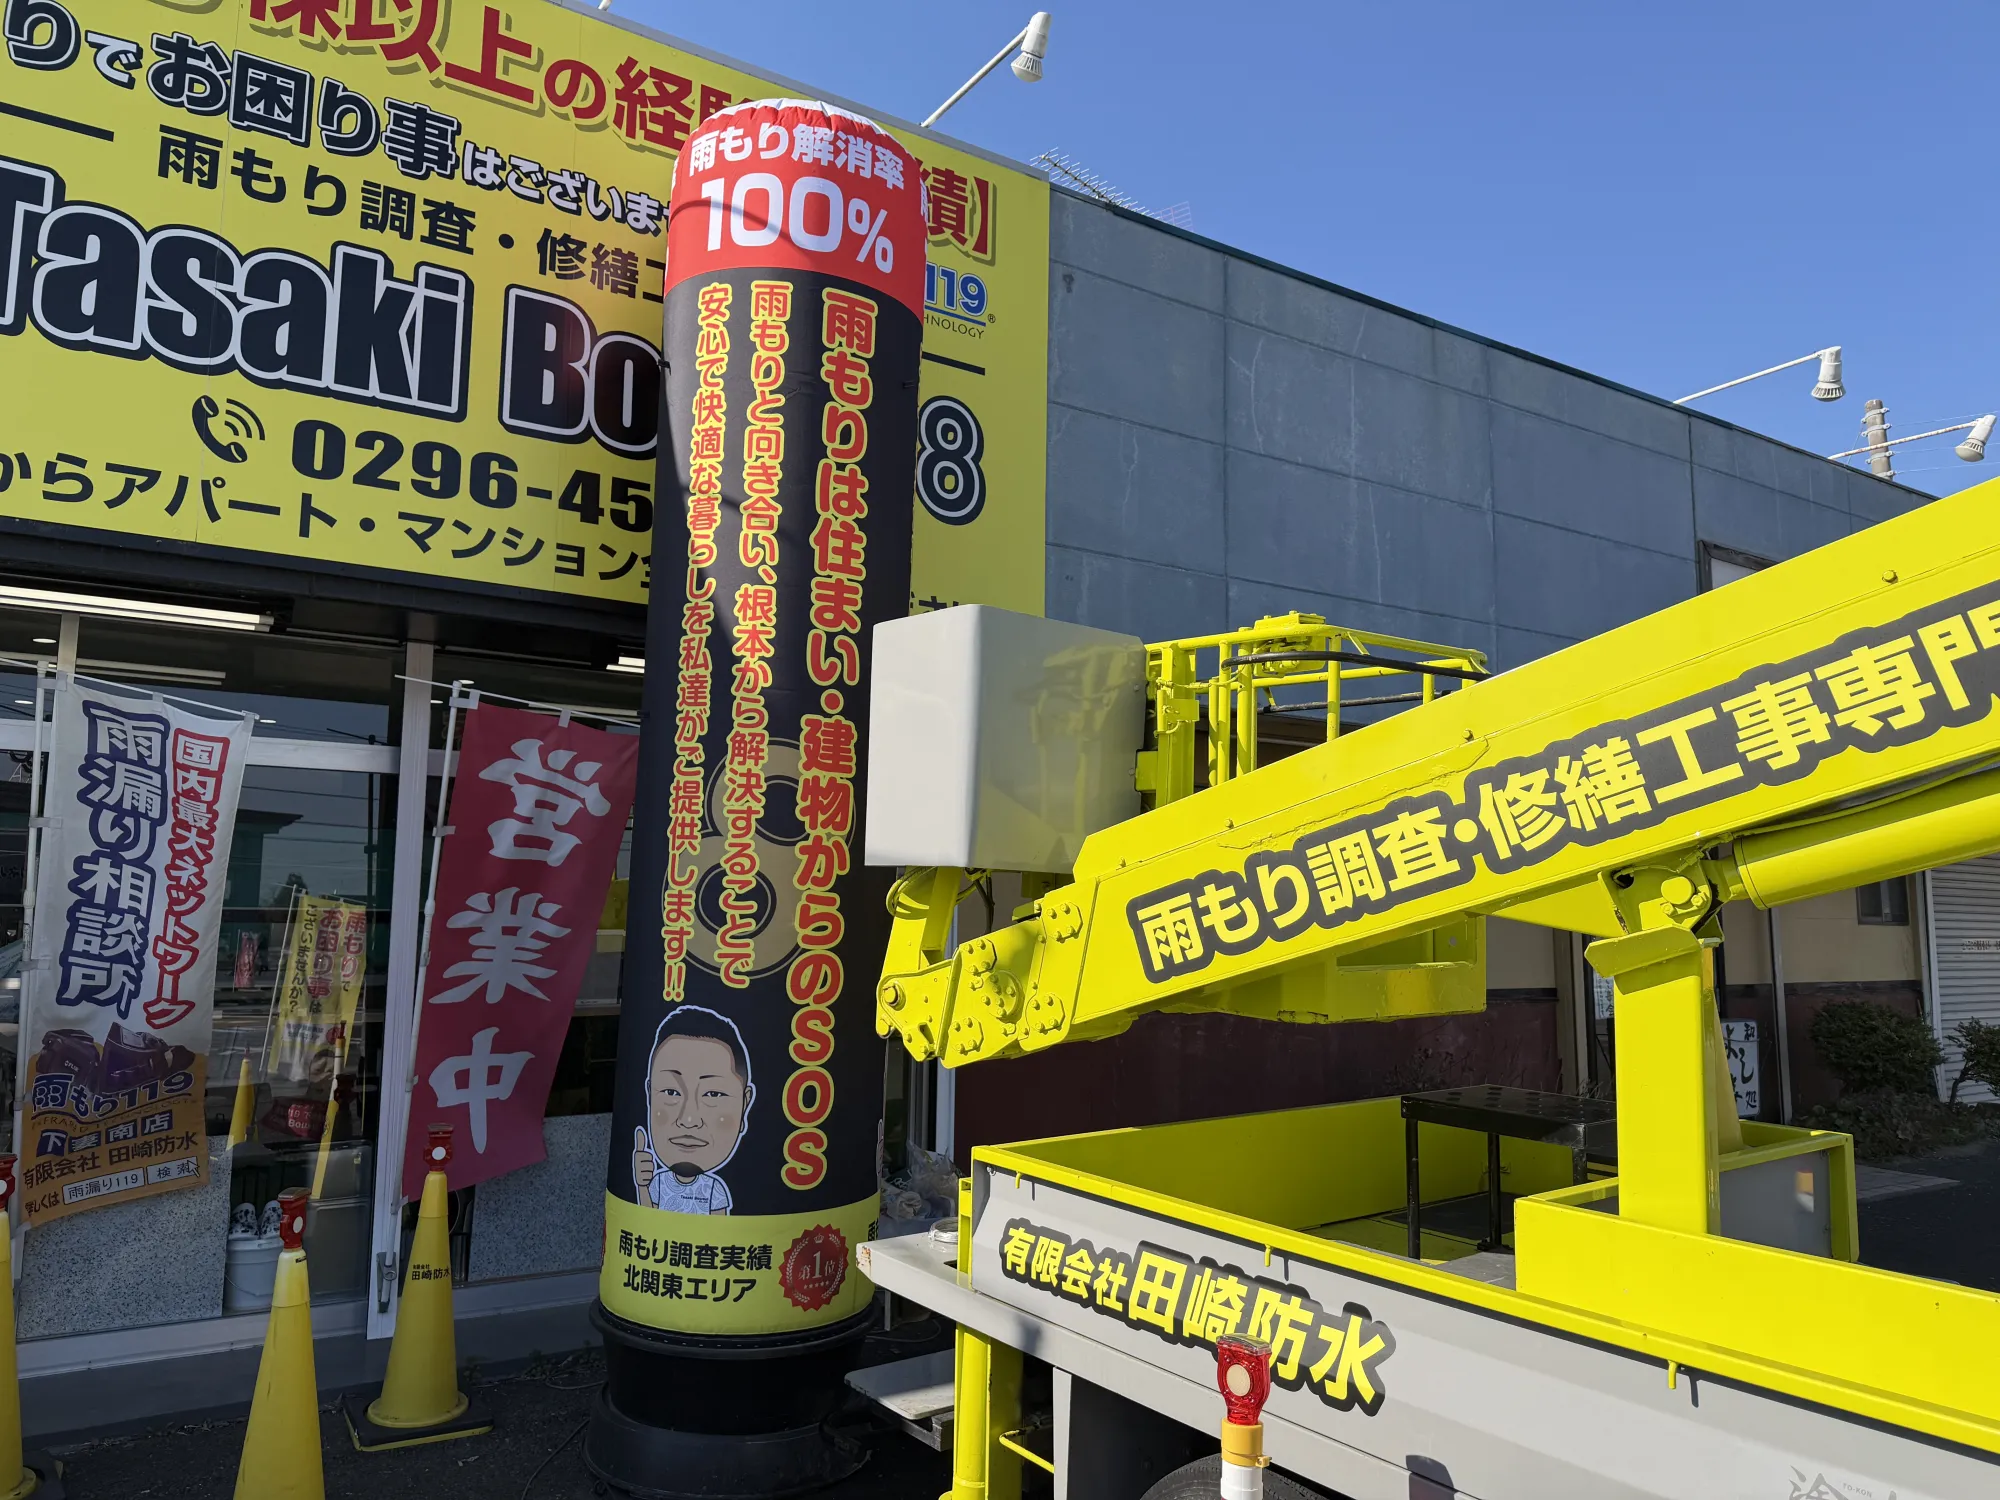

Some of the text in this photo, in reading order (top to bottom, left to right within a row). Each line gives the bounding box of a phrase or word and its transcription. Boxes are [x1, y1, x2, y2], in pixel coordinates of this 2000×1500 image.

[3, 0, 672, 237] りでお困り事はございま
[689, 122, 904, 190] 雨もり解消率
[701, 172, 894, 274] 100%
[714, 280, 794, 989] 雨もりと向き合い、根本から解決することで
[780, 286, 880, 1191] 雨もりは住まい・建物からのSOS
[1137, 599, 2000, 971] 雨もり調査・修繕工事専門
[56, 700, 170, 1019] 雨漏り相談所
[143, 728, 230, 1029] 国内最大ネットワーク
[429, 739, 611, 1154] 営業中
[23, 1131, 198, 1189] 有限会社 田崎防水
[31, 1071, 195, 1120] 雨もり119
[68, 1173, 139, 1199] 雨漏り119
[618, 1229, 773, 1271] 雨もり調査実績
[623, 1264, 757, 1303] 北関東エリア
